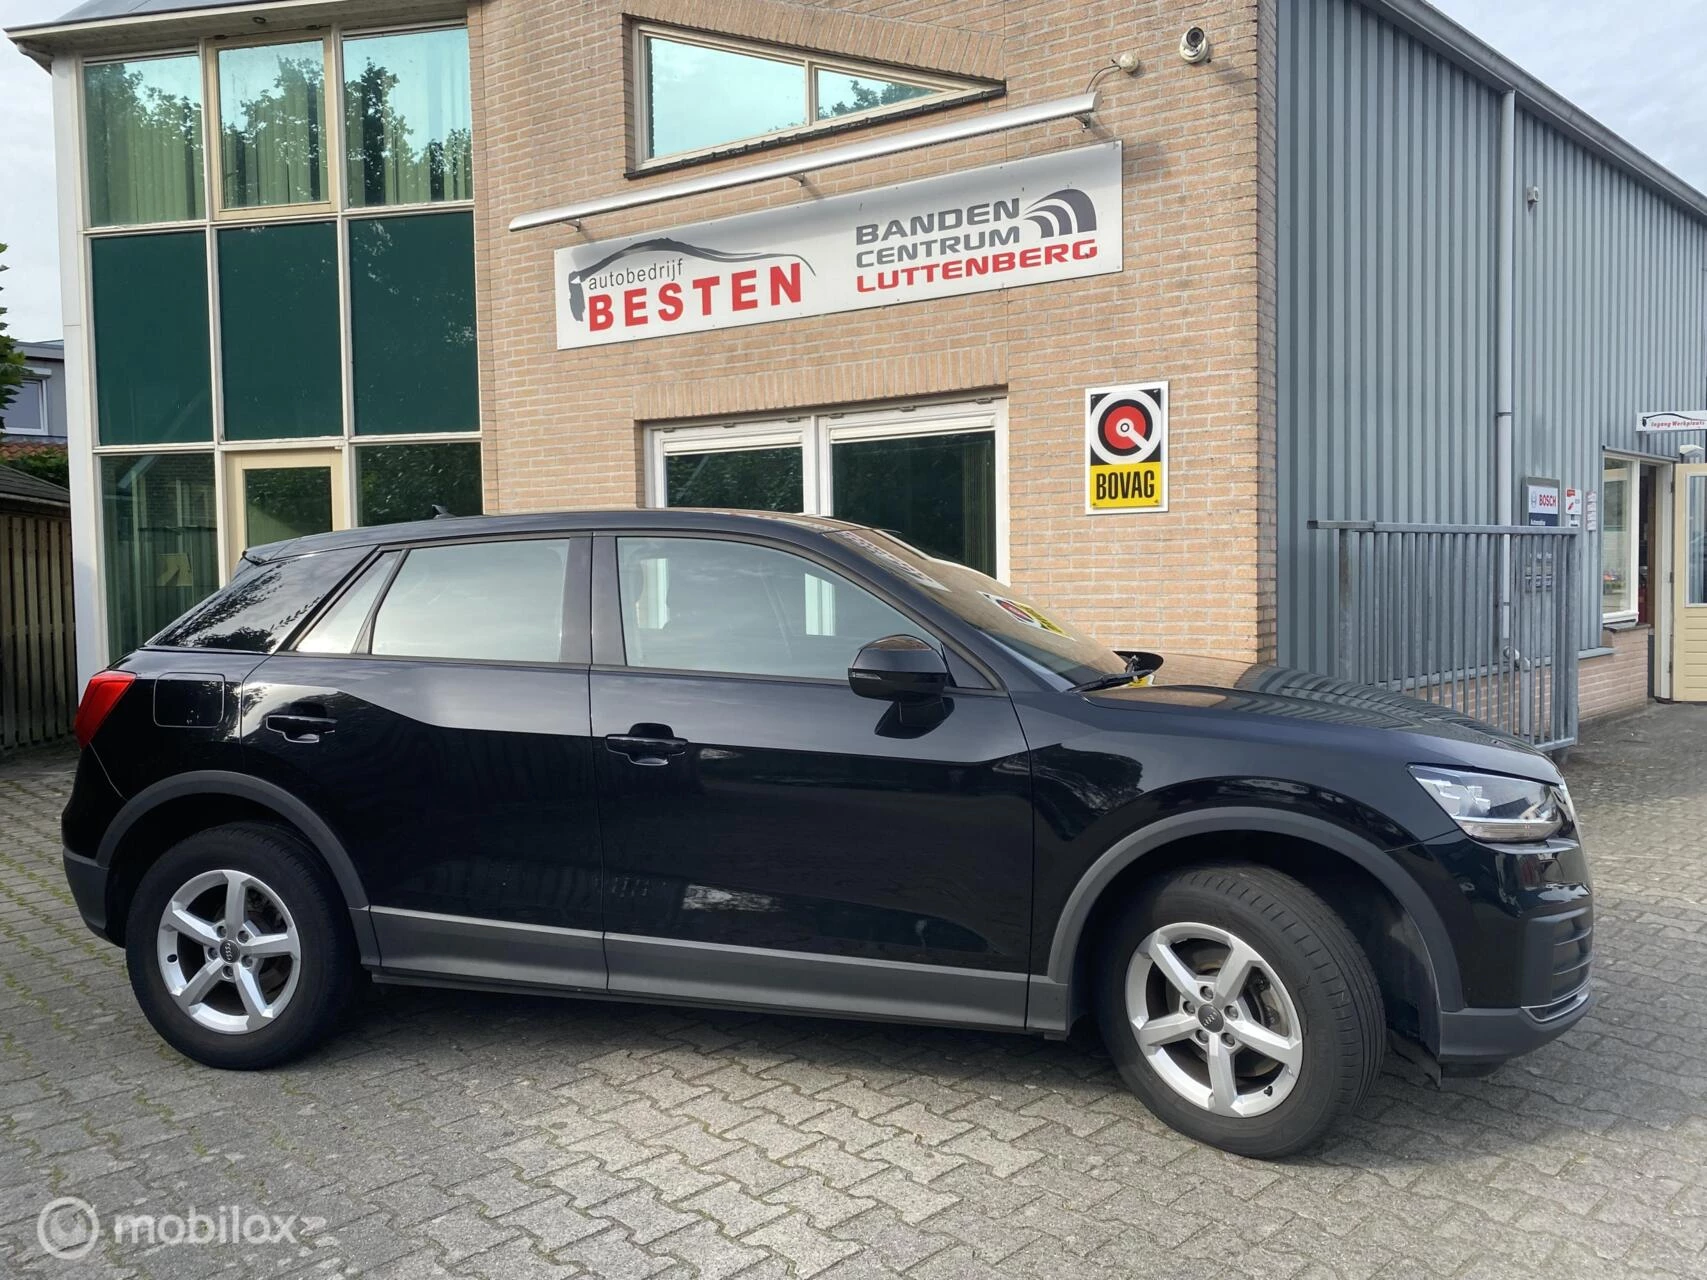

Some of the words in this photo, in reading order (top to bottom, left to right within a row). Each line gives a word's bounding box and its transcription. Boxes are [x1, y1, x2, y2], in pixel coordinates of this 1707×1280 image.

[856, 198, 1020, 245] BANDEN
[856, 225, 1020, 268] CENTRUM
[857, 238, 1098, 293] LUTTENBERG
[588, 257, 684, 290] autobedrijf
[588, 262, 801, 332] BESTEN
[1096, 470, 1155, 500] BOVAG
[1538, 494, 1557, 507] BOSCH
